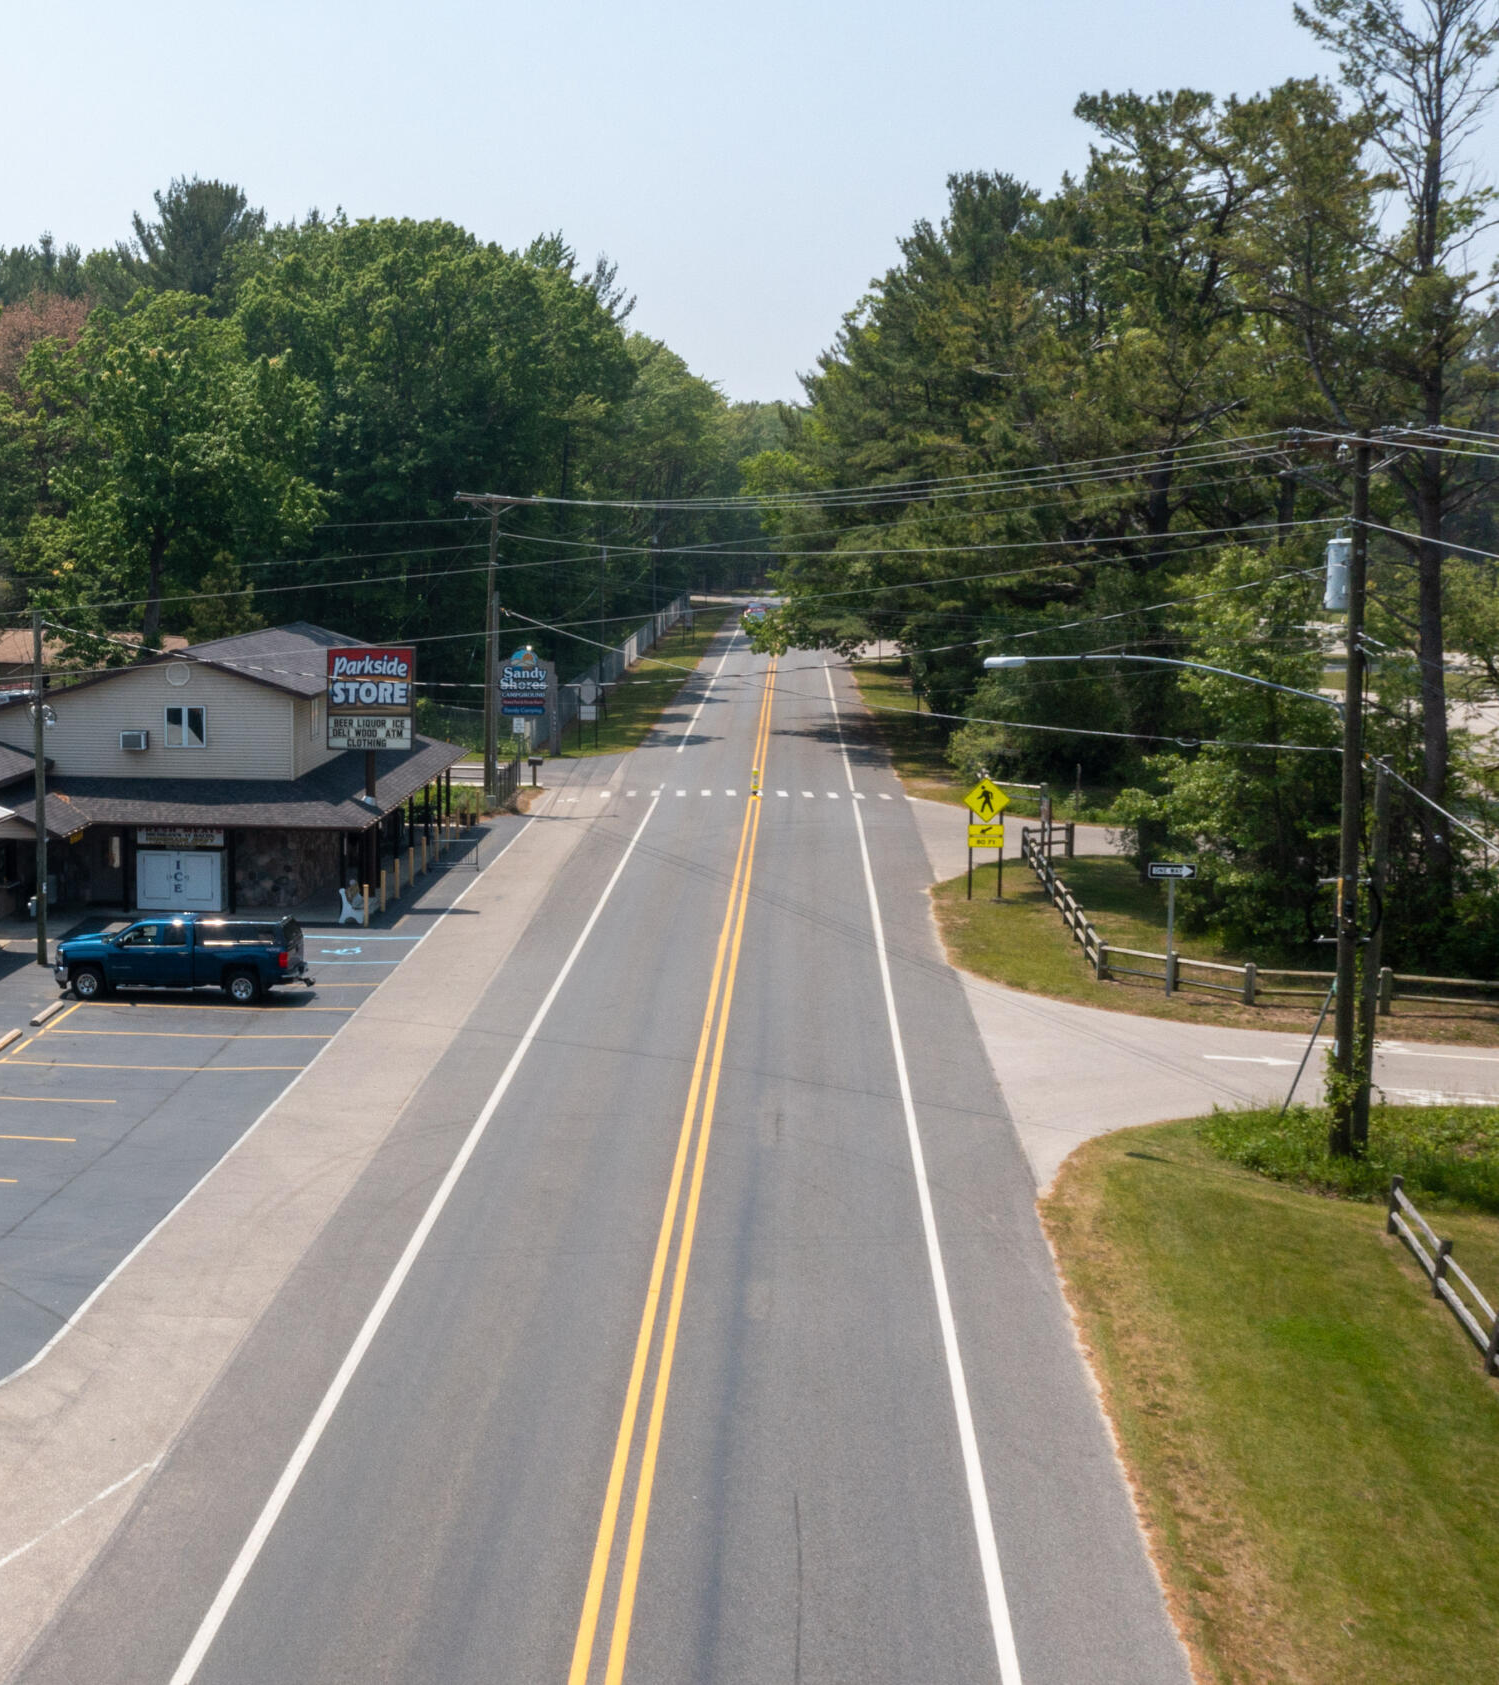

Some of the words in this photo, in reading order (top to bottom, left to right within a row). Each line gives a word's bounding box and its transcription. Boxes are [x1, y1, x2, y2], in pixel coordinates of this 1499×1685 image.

[332, 654, 408, 680] Parkside
[504, 667, 547, 680] Sandy
[500, 678, 547, 690] Shores
[332, 682, 408, 704] STORE
[334, 719, 353, 728] BEER
[357, 719, 386, 728] LIQUOR
[392, 719, 405, 728] ICE
[332, 728, 350, 737] DELI
[355, 728, 377, 737] WOOD
[386, 729, 403, 738] ATM
[347, 738, 387, 747] CLOTHING
[173, 860, 184, 893] ICE
